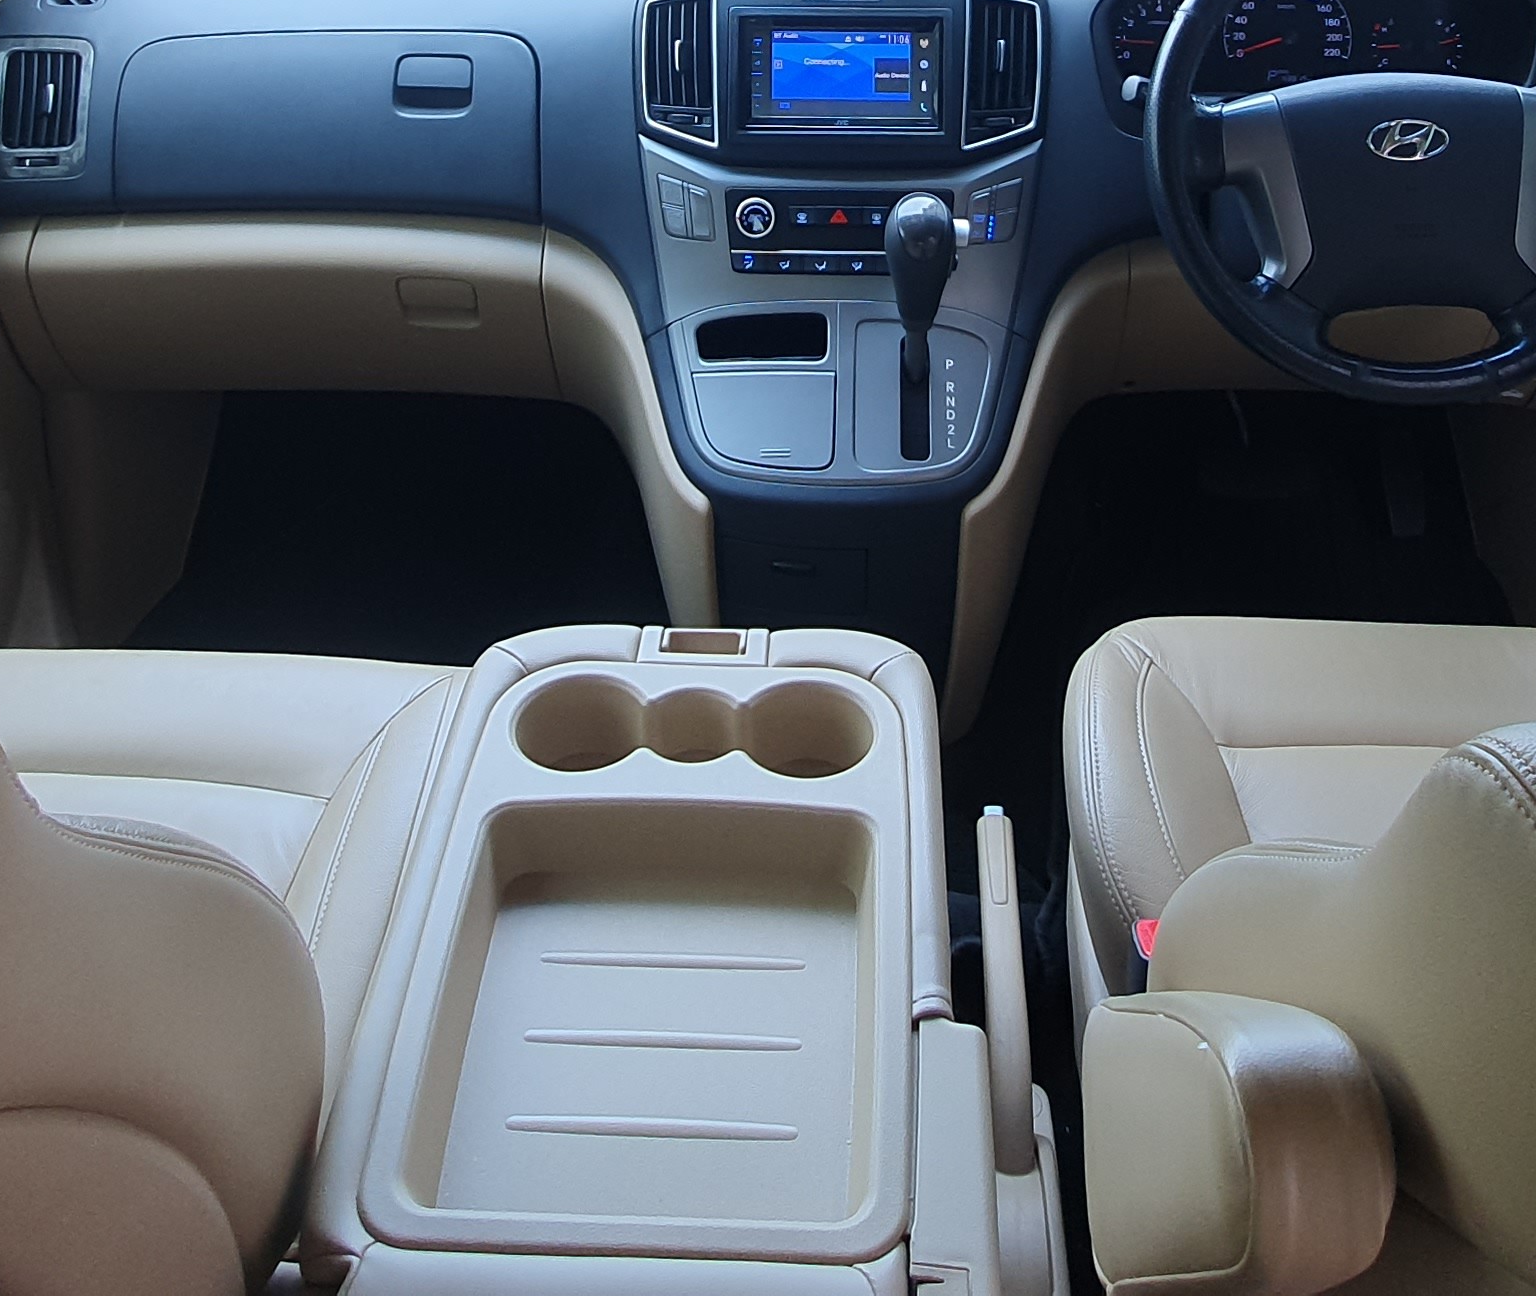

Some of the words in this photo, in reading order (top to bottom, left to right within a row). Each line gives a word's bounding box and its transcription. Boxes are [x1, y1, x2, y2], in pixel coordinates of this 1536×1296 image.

[1242, 1, 1255, 10] 60
[1316, 4, 1333, 13] 160
[1234, 15, 1248, 25] 40
[1324, 18, 1341, 27] 180
[888, 34, 910, 45] 11:06
[1233, 32, 1246, 41] 20
[1326, 33, 1343, 42] 200
[1123, 50, 1131, 59] 0
[1324, 48, 1341, 57] 220
[945, 359, 954, 370] P
[946, 381, 955, 393] R
[946, 396, 955, 407] N
[946, 409, 956, 420] D
[947, 424, 955, 435] 2
[947, 437, 955, 449] L
